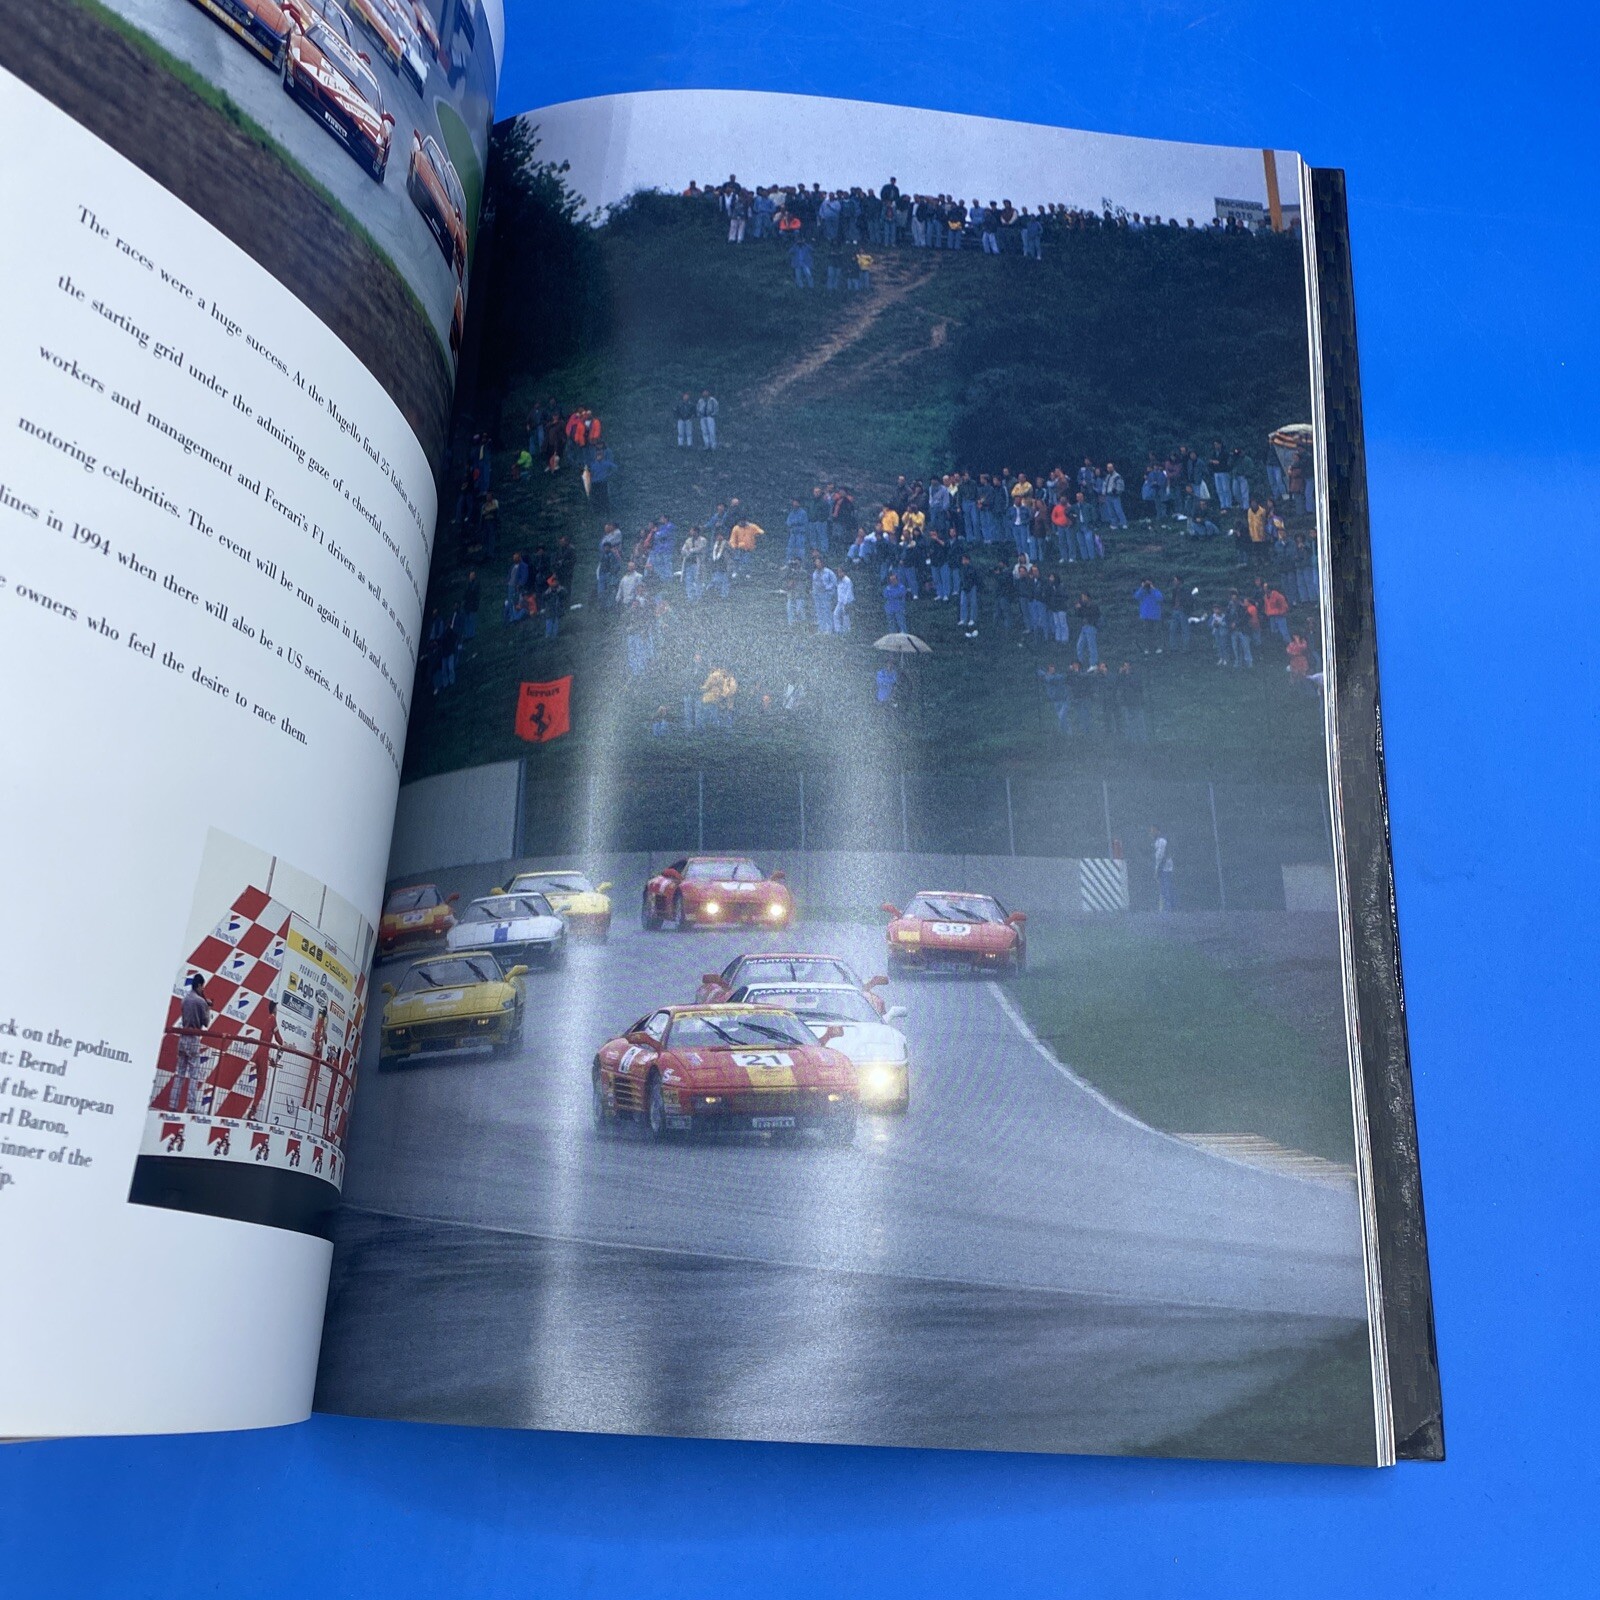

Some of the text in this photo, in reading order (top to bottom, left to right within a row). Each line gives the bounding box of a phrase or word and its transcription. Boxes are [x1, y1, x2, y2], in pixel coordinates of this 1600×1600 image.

[1216, 200, 1263, 212] PARCHEGGIO
[1228, 210, 1253, 220] MOTO
[78, 204, 110, 239] The
[116, 237, 154, 271] races
[160, 268, 193, 300] were
[198, 298, 206, 310] a
[211, 302, 242, 336] huge
[246, 334, 289, 376] success.
[293, 371, 305, 390] At
[308, 384, 324, 406] the
[327, 399, 361, 442] Mugello
[363, 436, 380, 464] final
[380, 458, 390, 476] 25
[391, 470, 408, 502] Italian
[58, 275, 85, 302] the
[91, 299, 150, 349] starting
[154, 341, 184, 368] grid
[188, 362, 230, 400] under
[232, 394, 253, 417] the
[257, 414, 306, 464] admiring
[308, 456, 330, 480] gaze
[332, 478, 344, 492] of
[344, 489, 350, 500] a
[352, 496, 382, 534] cheerful
[382, 531, 400, 558] crowd
[40, 345, 105, 394] workers
[111, 390, 141, 416] and
[146, 411, 233, 477] management
[237, 472, 260, 496] and
[265, 486, 309, 532] Ferrari's
[312, 524, 325, 546] F1
[328, 540, 356, 574] drivers
[358, 571, 366, 584] as
[368, 580, 382, 601] well
[382, 598, 388, 610] as
[389, 608, 396, 621] an
[18, 417, 97, 473] motoring
[102, 464, 180, 518] celebrities.
[188, 508, 214, 537] The
[218, 534, 252, 562] event
[256, 557, 277, 580] will
[280, 570, 294, 591] be
[297, 587, 314, 608] run
[317, 602, 340, 629] again
[342, 620, 350, 638] in
[352, 629, 368, 658] Italy
[369, 651, 381, 668] and
[381, 662, 389, 679] the
[46, 509, 63, 532] in
[72, 522, 110, 557] 1994
[118, 550, 157, 582] when
[164, 574, 200, 605] there
[204, 599, 228, 622] will
[232, 616, 255, 638] also
[260, 629, 273, 650] be
[277, 645, 283, 658] a
[288, 646, 303, 669] US
[304, 664, 330, 691] series.
[333, 683, 342, 701] As
[345, 694, 357, 712] the
[358, 707, 380, 734] number
[16, 583, 78, 620] owners
[87, 616, 120, 641] who
[128, 632, 156, 659] feel
[162, 652, 184, 674] the
[192, 666, 230, 698] desire
[235, 691, 248, 708] to
[254, 702, 276, 725] race
[281, 717, 308, 745] them.
[301, 938, 324, 962] 348
[298, 978, 314, 999] Agip
[22, 1029, 43, 1042] on
[47, 1029, 72, 1048] the
[74, 1040, 132, 1064] podium.
[742, 1054, 782, 1066] 21
[19, 1050, 68, 1076] Bernd
[12, 1080, 38, 1099] the
[42, 1084, 114, 1115] European
[18, 1109, 69, 1137] Baron,
[48, 1146, 68, 1163] of
[68, 1148, 93, 1167] the
